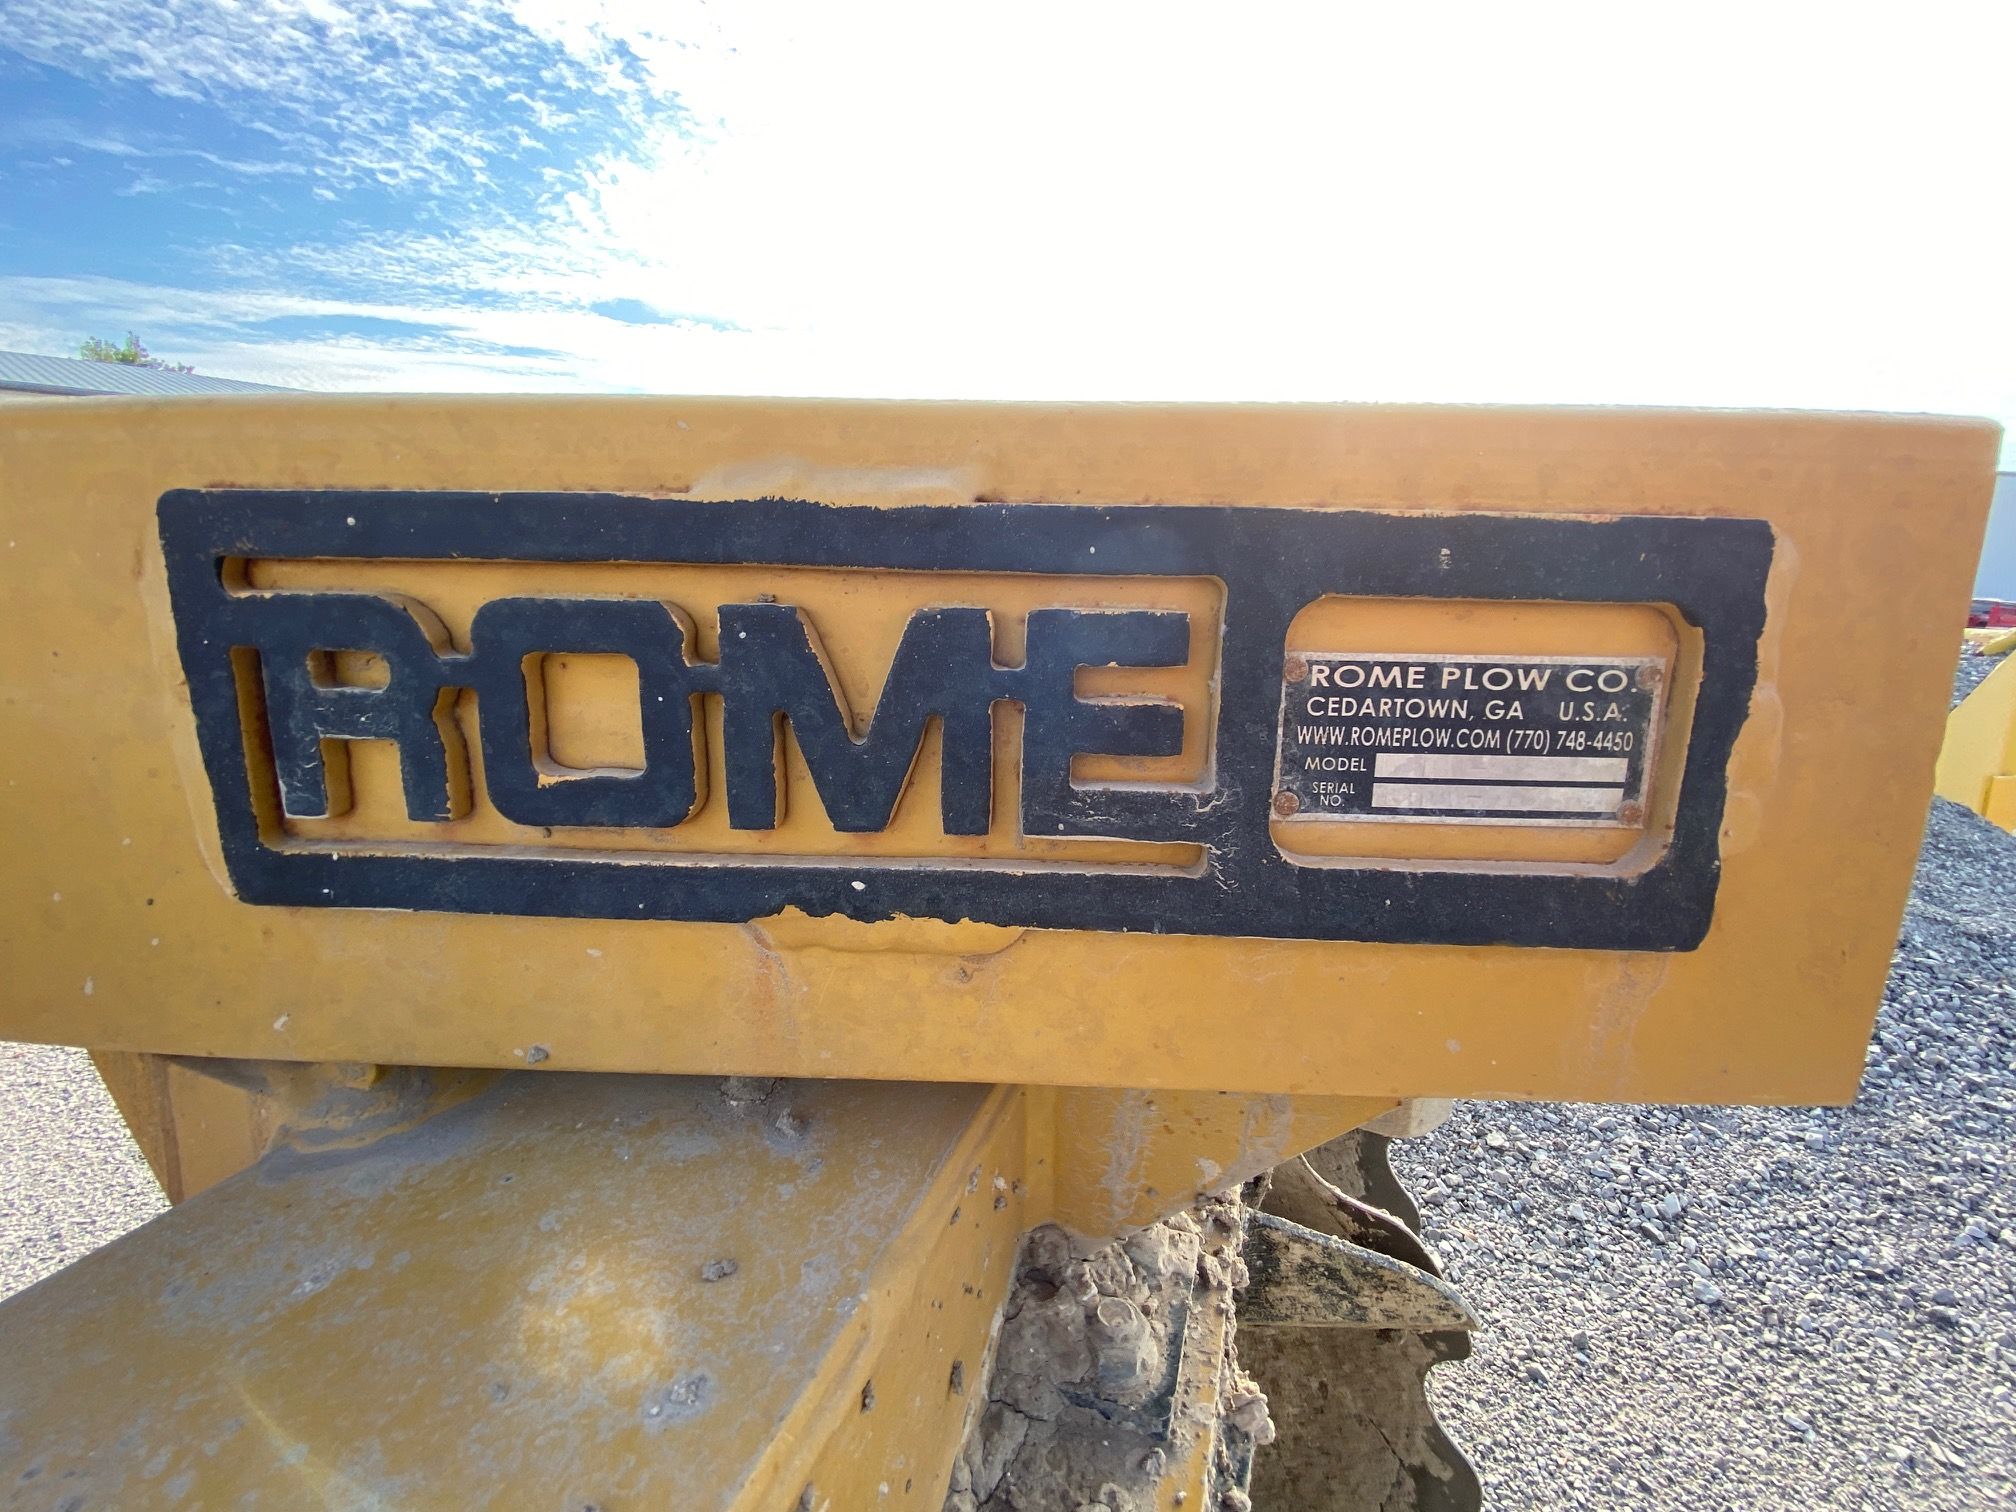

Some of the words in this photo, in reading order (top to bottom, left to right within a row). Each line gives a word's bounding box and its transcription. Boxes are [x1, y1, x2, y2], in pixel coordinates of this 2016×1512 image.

[1310, 665, 1425, 689] ROME
[1441, 667, 1553, 692] PLOW
[1565, 668, 1638, 693] CO.
[240, 594, 1192, 838] ROME
[1306, 696, 1475, 721] CEDARTOWN,
[1485, 700, 1524, 720] GA
[1559, 701, 1628, 722] U.S.A.
[1297, 726, 1500, 749] WWW.ROMEPLOW.COM
[1506, 728, 1550, 755] (770)
[1556, 730, 1633, 753] 748-4450
[1304, 757, 1367, 772] MODEL
[1312, 782, 1355, 795] SERIAL
[1320, 794, 1345, 808] NO.
